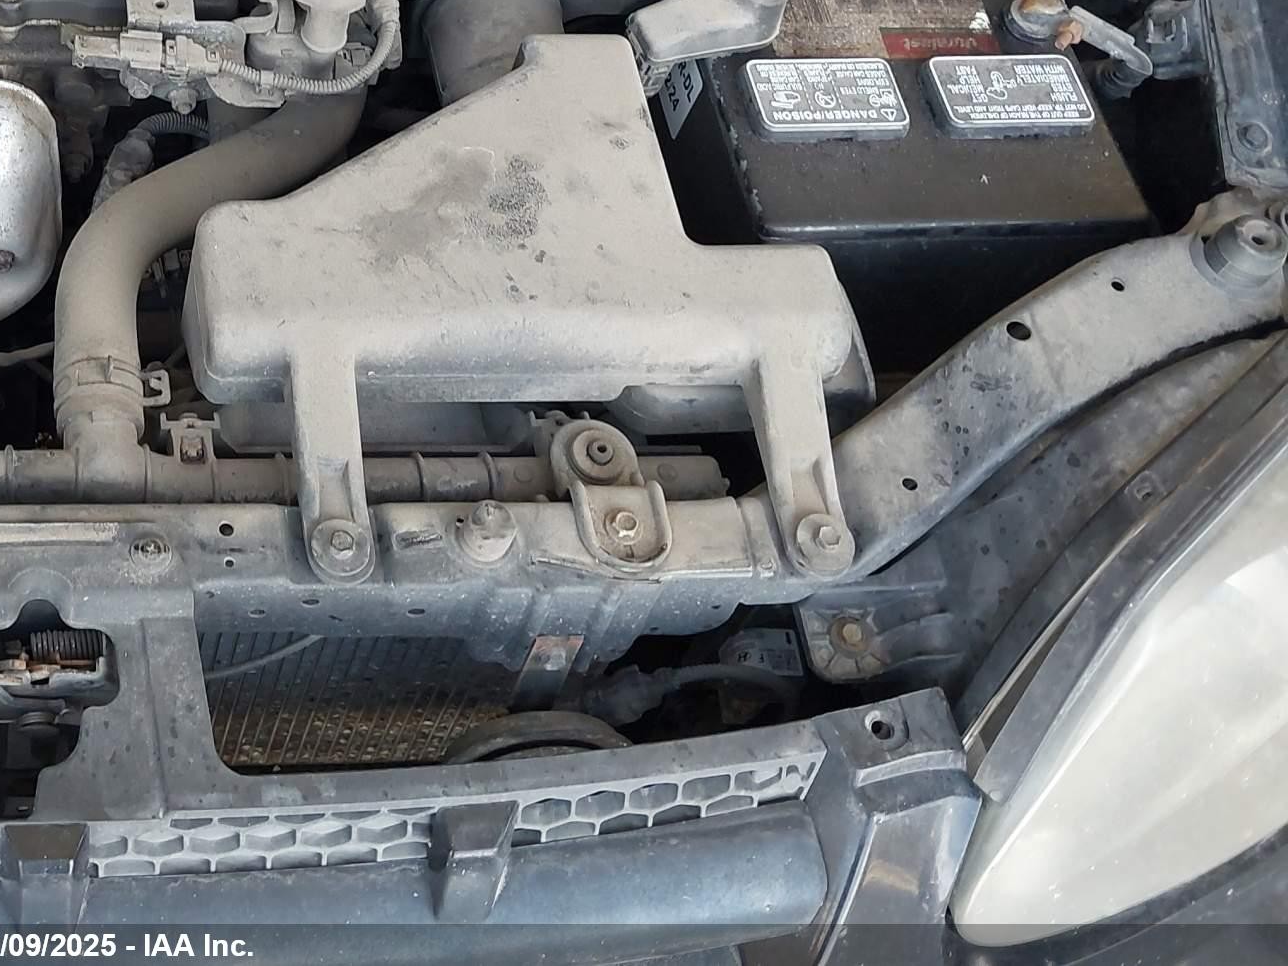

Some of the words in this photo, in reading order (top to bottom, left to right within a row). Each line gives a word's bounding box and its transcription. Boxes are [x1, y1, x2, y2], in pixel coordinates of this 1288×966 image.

[955, 65, 976, 75] FAST
[1014, 65, 1042, 74] WATER
[1043, 65, 1066, 74] WITH
[959, 75, 980, 84] HELP
[1016, 74, 1069, 85] IMMEDIATELY
[947, 84, 984, 93] MEDICAL
[1051, 83, 1073, 92] EYES
[971, 93, 988, 102] GET
[1050, 92, 1078, 102] FLUSH
[772, 109, 878, 121] DANGER/POISON
